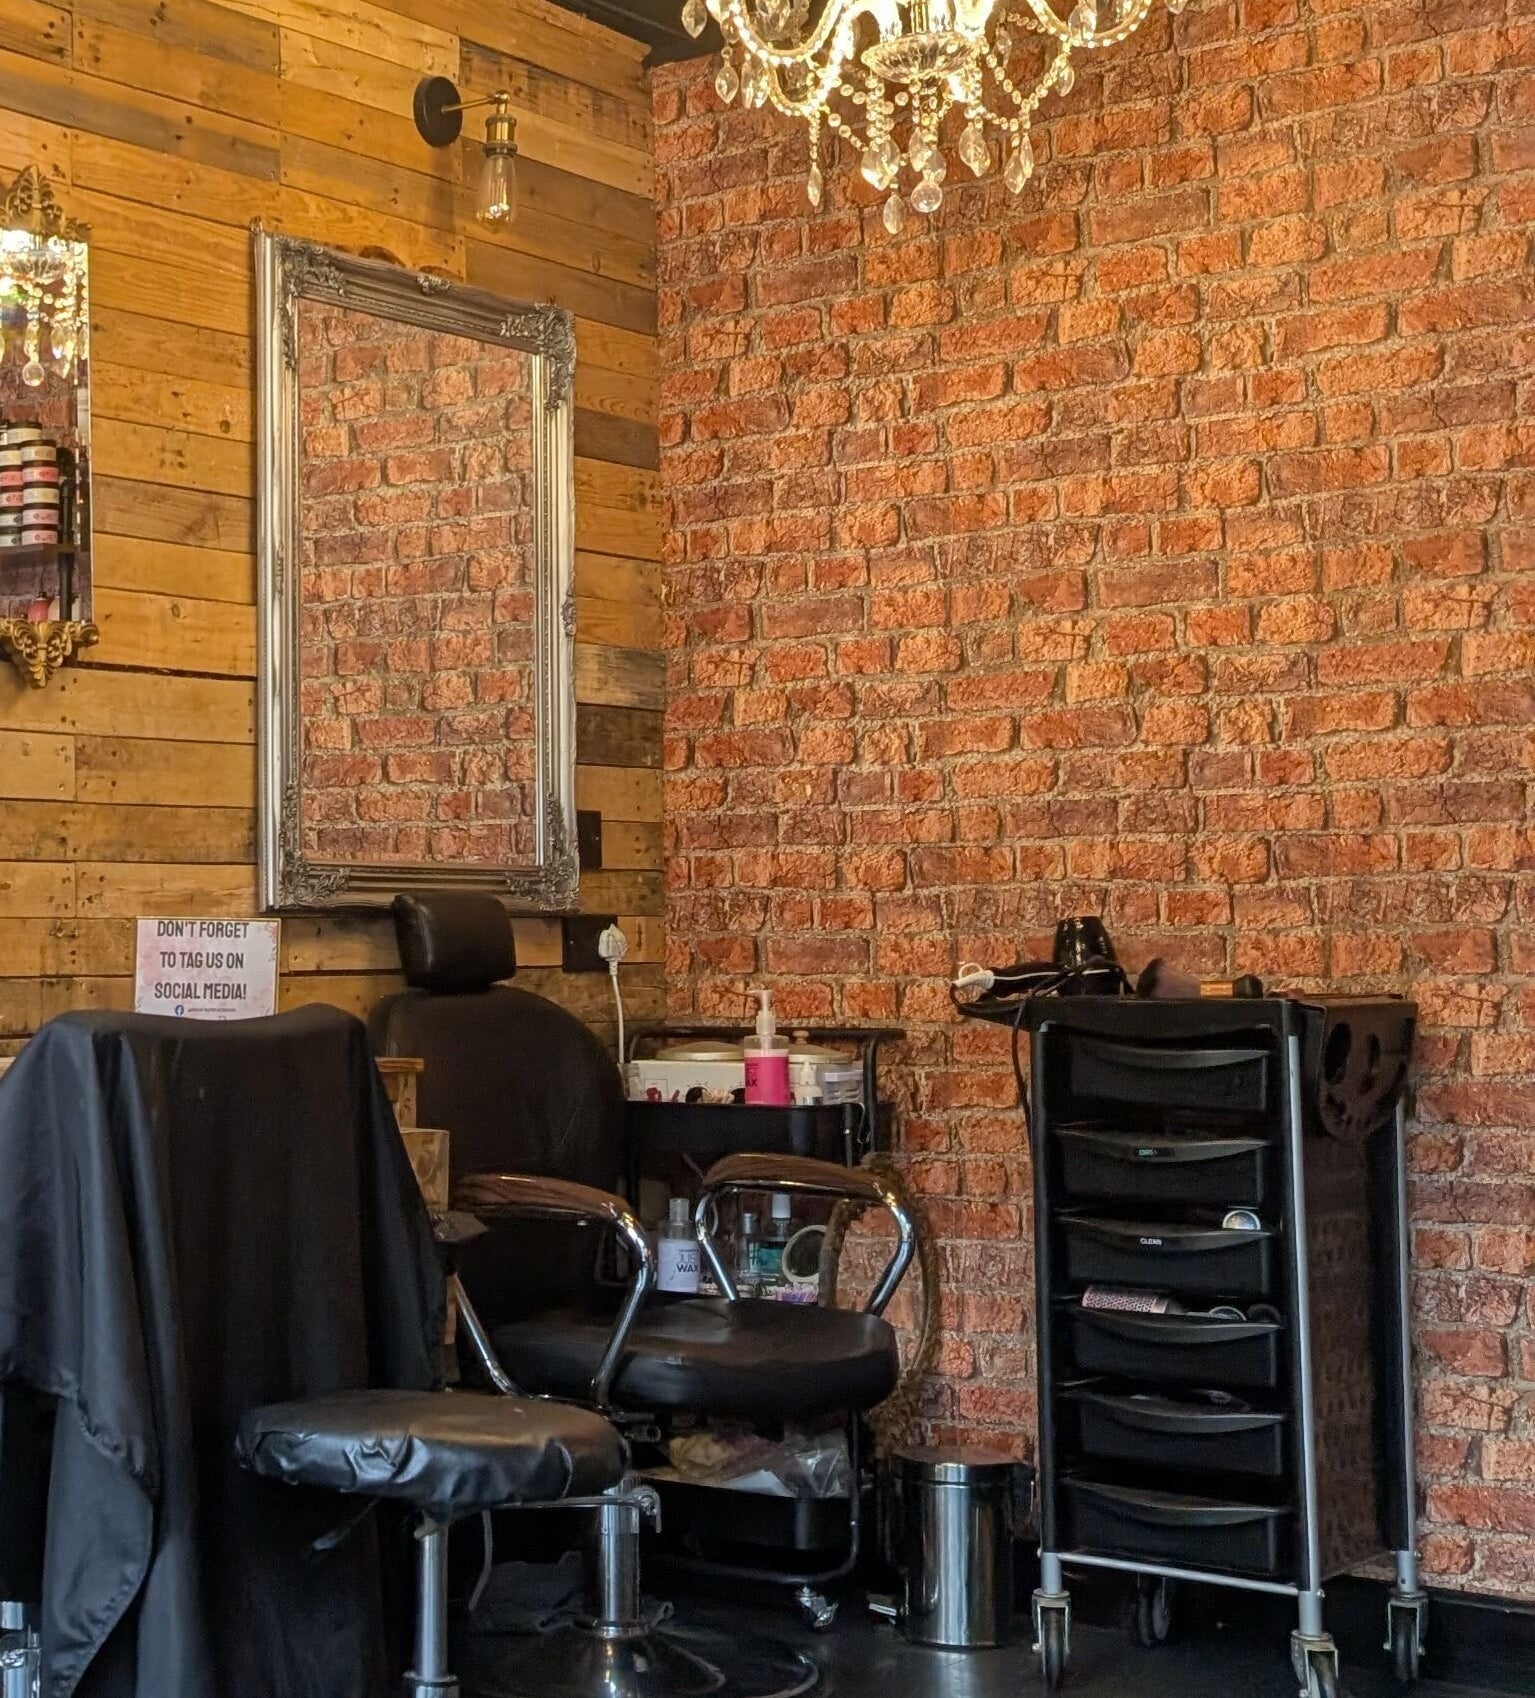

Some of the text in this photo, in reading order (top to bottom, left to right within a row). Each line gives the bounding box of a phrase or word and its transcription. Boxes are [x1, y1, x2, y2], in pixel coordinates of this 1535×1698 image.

[157, 920, 249, 938] DON'T FORGET
[160, 951, 244, 969] TO TAG US ON
[154, 982, 247, 1000] SOCIAL MEDIA!
